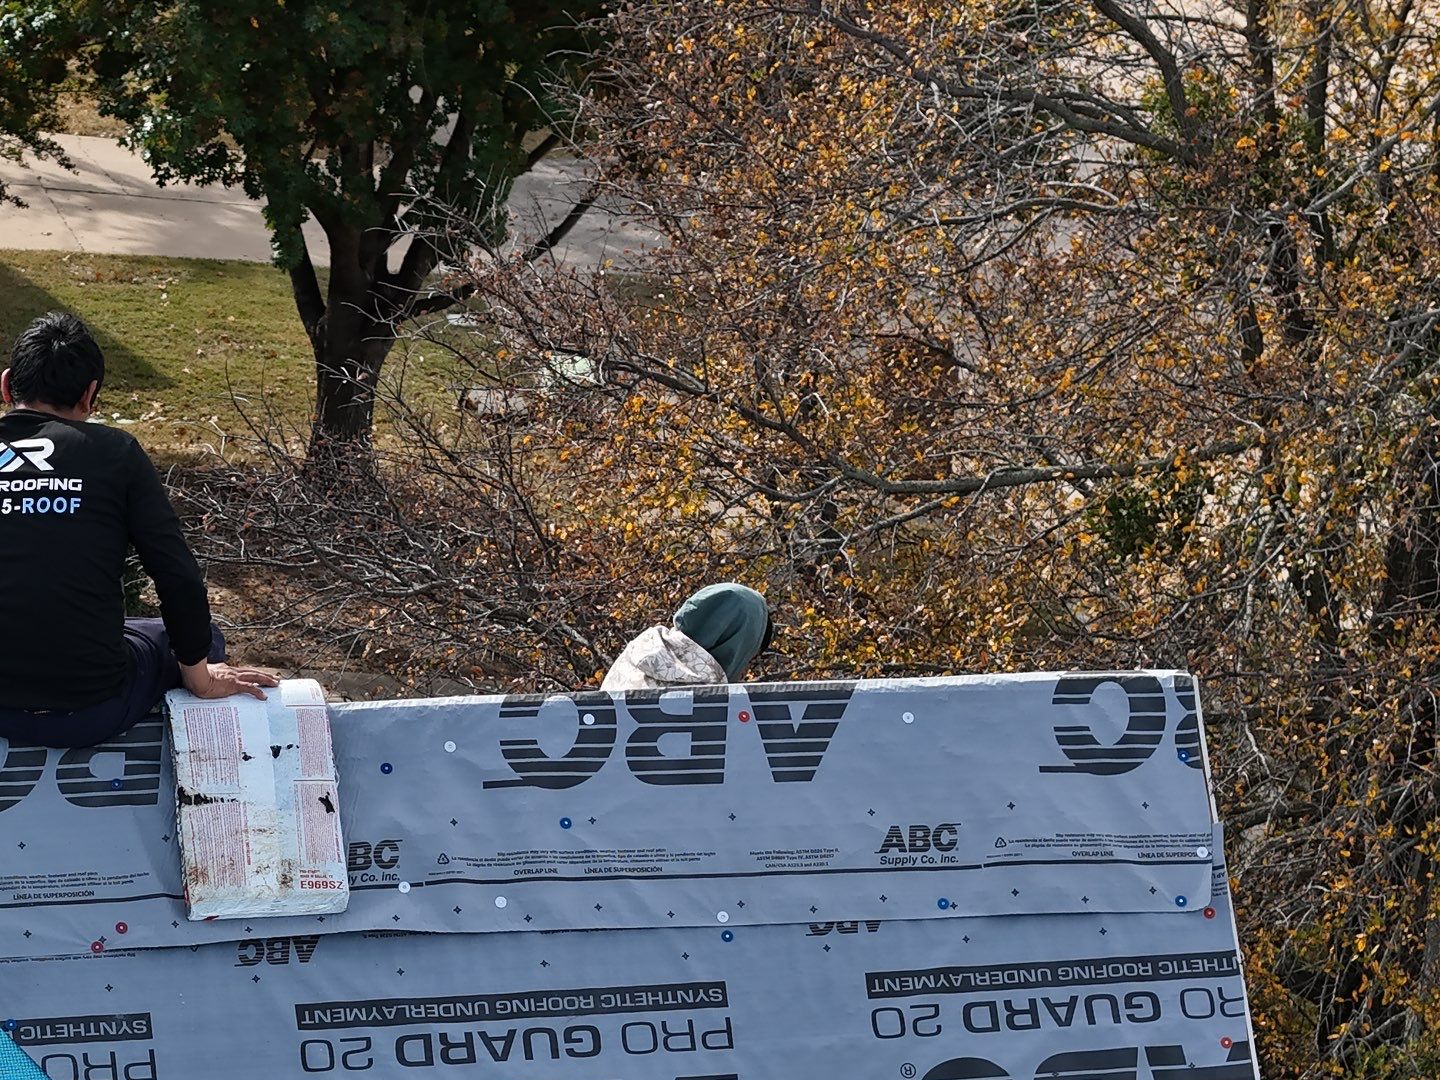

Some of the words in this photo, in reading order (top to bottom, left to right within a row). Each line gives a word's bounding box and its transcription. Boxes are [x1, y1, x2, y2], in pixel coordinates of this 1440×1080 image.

[874, 823, 961, 853] ABC
[880, 855, 918, 866] Supply
[871, 967, 1051, 994] UNDERLAYMENT
[1058, 961, 1152, 980] ROOFING
[497, 994, 594, 1014] ROOFING
[602, 988, 723, 1009] SYNTHETIC
[301, 1001, 490, 1026] UNDERLAYMENT
[871, 1003, 942, 1040] 20
[962, 991, 1162, 1034] GUARD
[19, 1019, 147, 1040] SYNTHETIC
[620, 1016, 734, 1054] PRO
[300, 1036, 374, 1073] 20
[394, 1025, 602, 1068] GUARD
